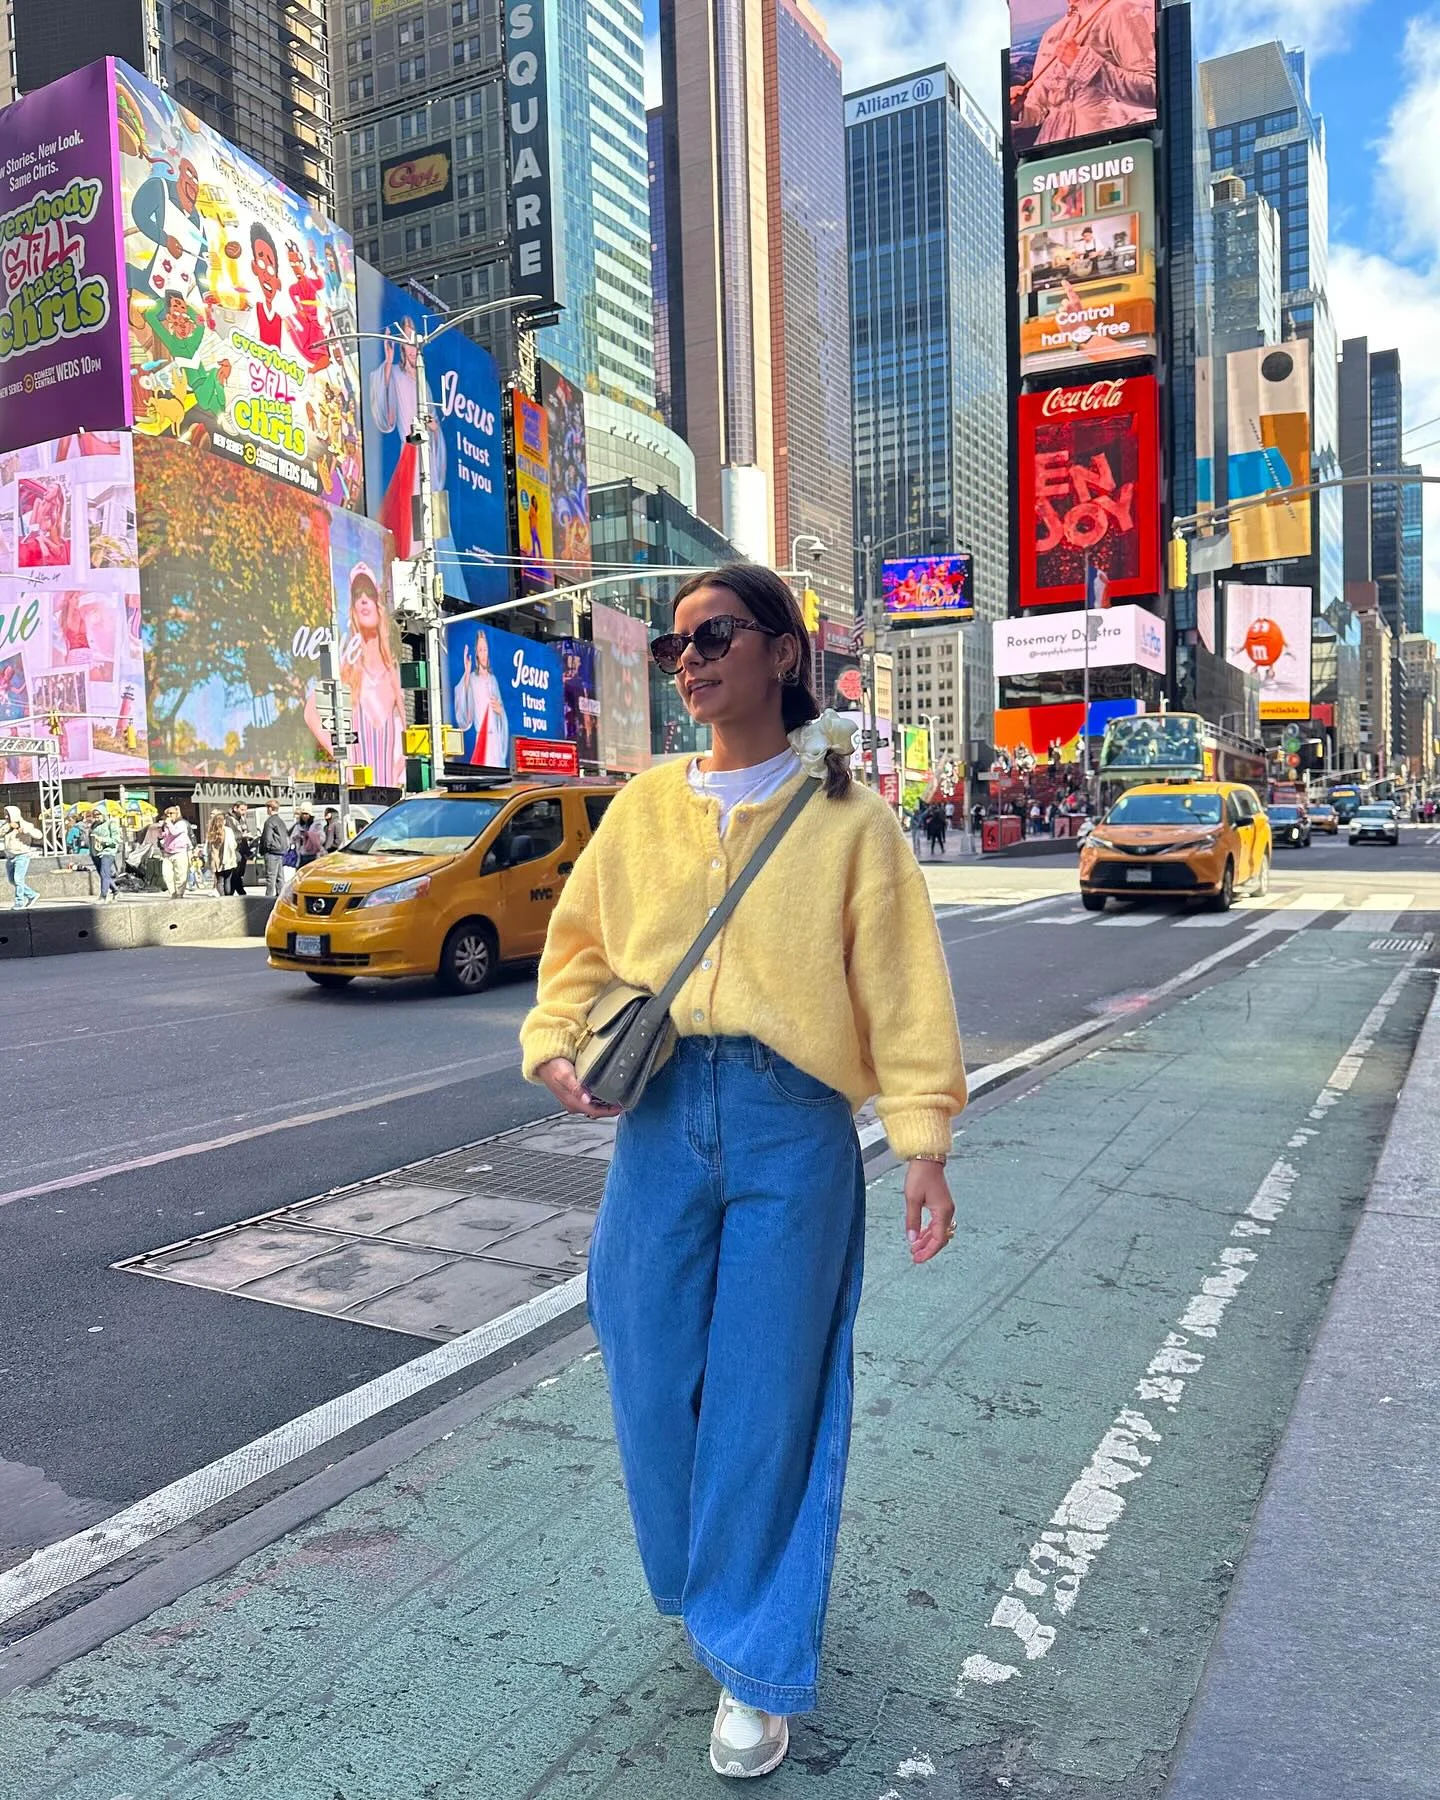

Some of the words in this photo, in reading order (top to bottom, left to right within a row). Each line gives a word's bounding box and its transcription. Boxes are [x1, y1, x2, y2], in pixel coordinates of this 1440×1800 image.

[856, 90, 909, 118] Allianz
[6, 152, 37, 175] Stories.
[38, 141, 57, 159] New
[58, 129, 84, 151] Look.
[508, 4, 542, 277] SQUARE
[9, 172, 31, 192] Same
[33, 160, 59, 180] Chris.
[1032, 156, 1134, 193] SAMSUNG
[0, 183, 97, 245] verybody
[21, 256, 74, 304] hates
[1055, 303, 1115, 325] Control
[1041, 321, 1130, 347] hands-free
[56, 359, 80, 381] WEDS
[81, 356, 102, 375] 10PM
[232, 332, 305, 386] everybody
[33, 366, 55, 380] COMEDY
[35, 375, 57, 389] CENTRAL
[9, 381, 23, 395] SERIES
[260, 395, 292, 416] hates
[442, 370, 495, 436] Jesus
[462, 437, 490, 467] trust
[279, 458, 300, 483] WEDS
[458, 459, 469, 481] in
[471, 470, 492, 494] you
[1007, 632, 1067, 648] Rosemary
[1071, 627, 1121, 643] Dystra
[1251, 645, 1268, 660] m
[511, 649, 550, 690] Jesus
[527, 693, 546, 712] trust
[523, 712, 532, 728] in
[531, 717, 547, 733] you
[194, 782, 273, 798] AMERICAN
[530, 888, 553, 902] NYC
